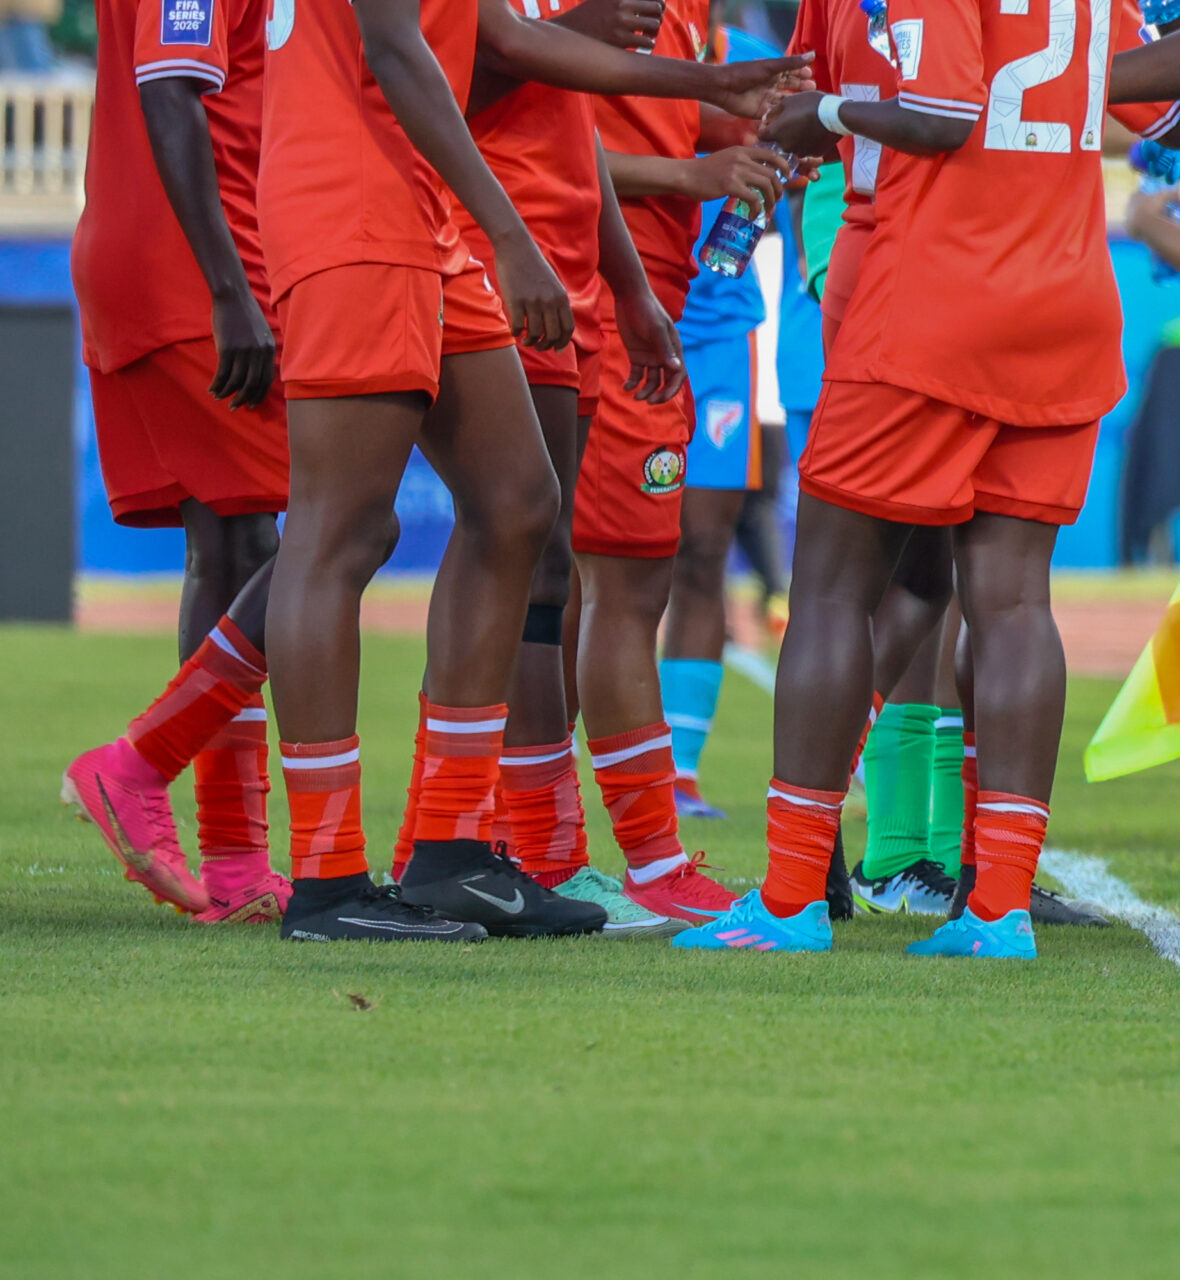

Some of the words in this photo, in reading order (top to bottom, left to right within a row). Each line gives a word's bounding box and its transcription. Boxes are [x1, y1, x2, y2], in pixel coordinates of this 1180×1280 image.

[175, 0, 200, 11] FIFA
[168, 10, 206, 21] SERIES
[172, 21, 200, 31] 2026
